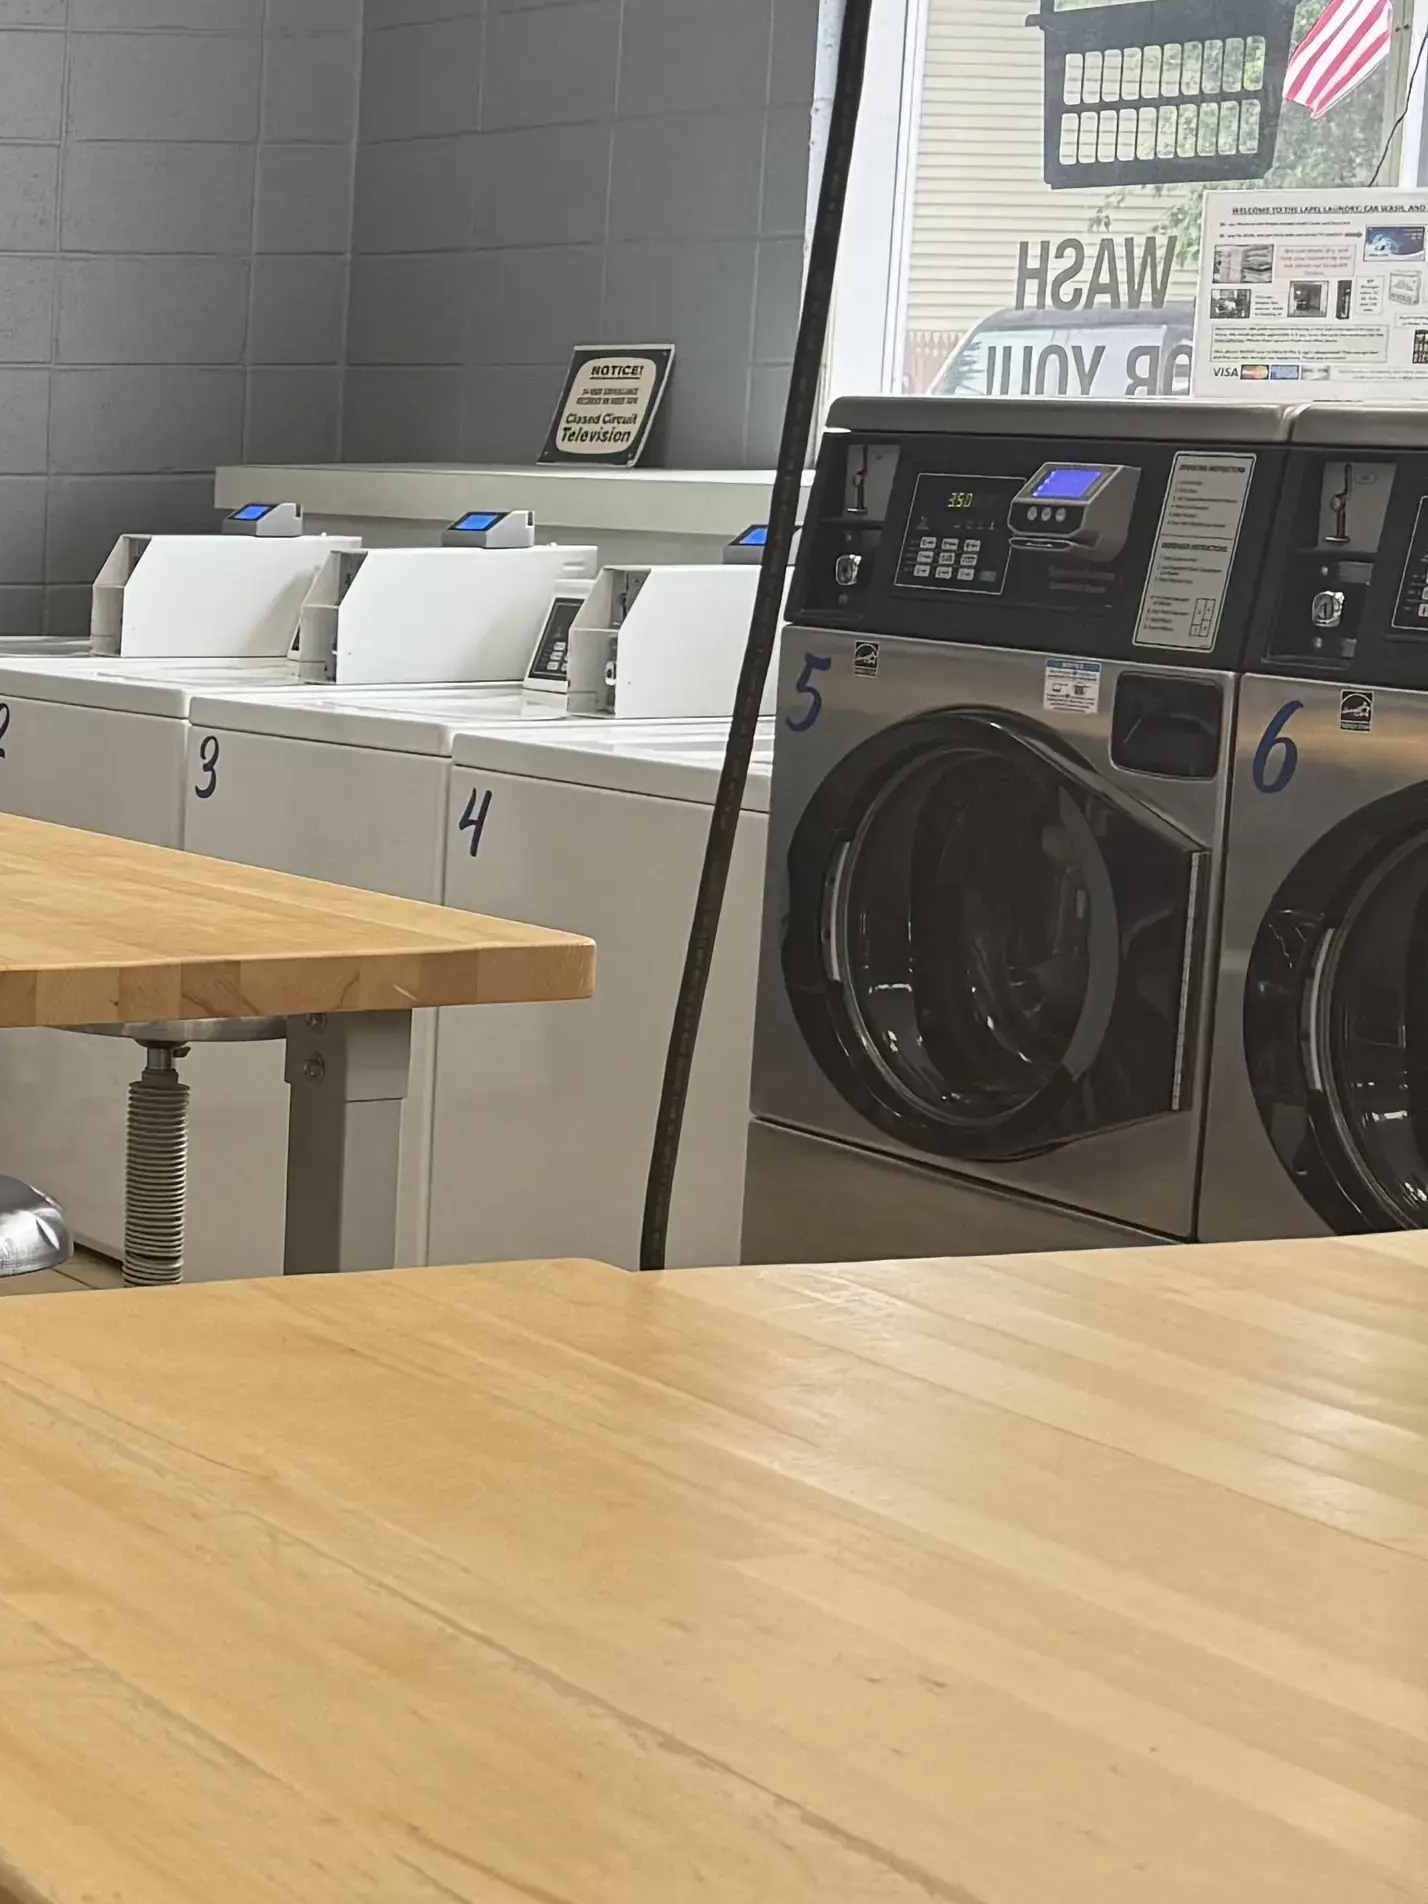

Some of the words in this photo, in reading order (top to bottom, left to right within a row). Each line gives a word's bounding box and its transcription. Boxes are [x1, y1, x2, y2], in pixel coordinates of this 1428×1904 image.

[1232, 206, 1269, 215] WELCOME
[590, 365, 644, 376] NOTICE!
[1213, 367, 1239, 377] VISA
[565, 412, 601, 425] Closed
[602, 412, 638, 425] Circuit
[561, 426, 632, 443] Television
[784, 652, 832, 732] 5
[1252, 699, 1304, 794] 6
[194, 735, 220, 800] 3
[457, 787, 493, 859] 4
